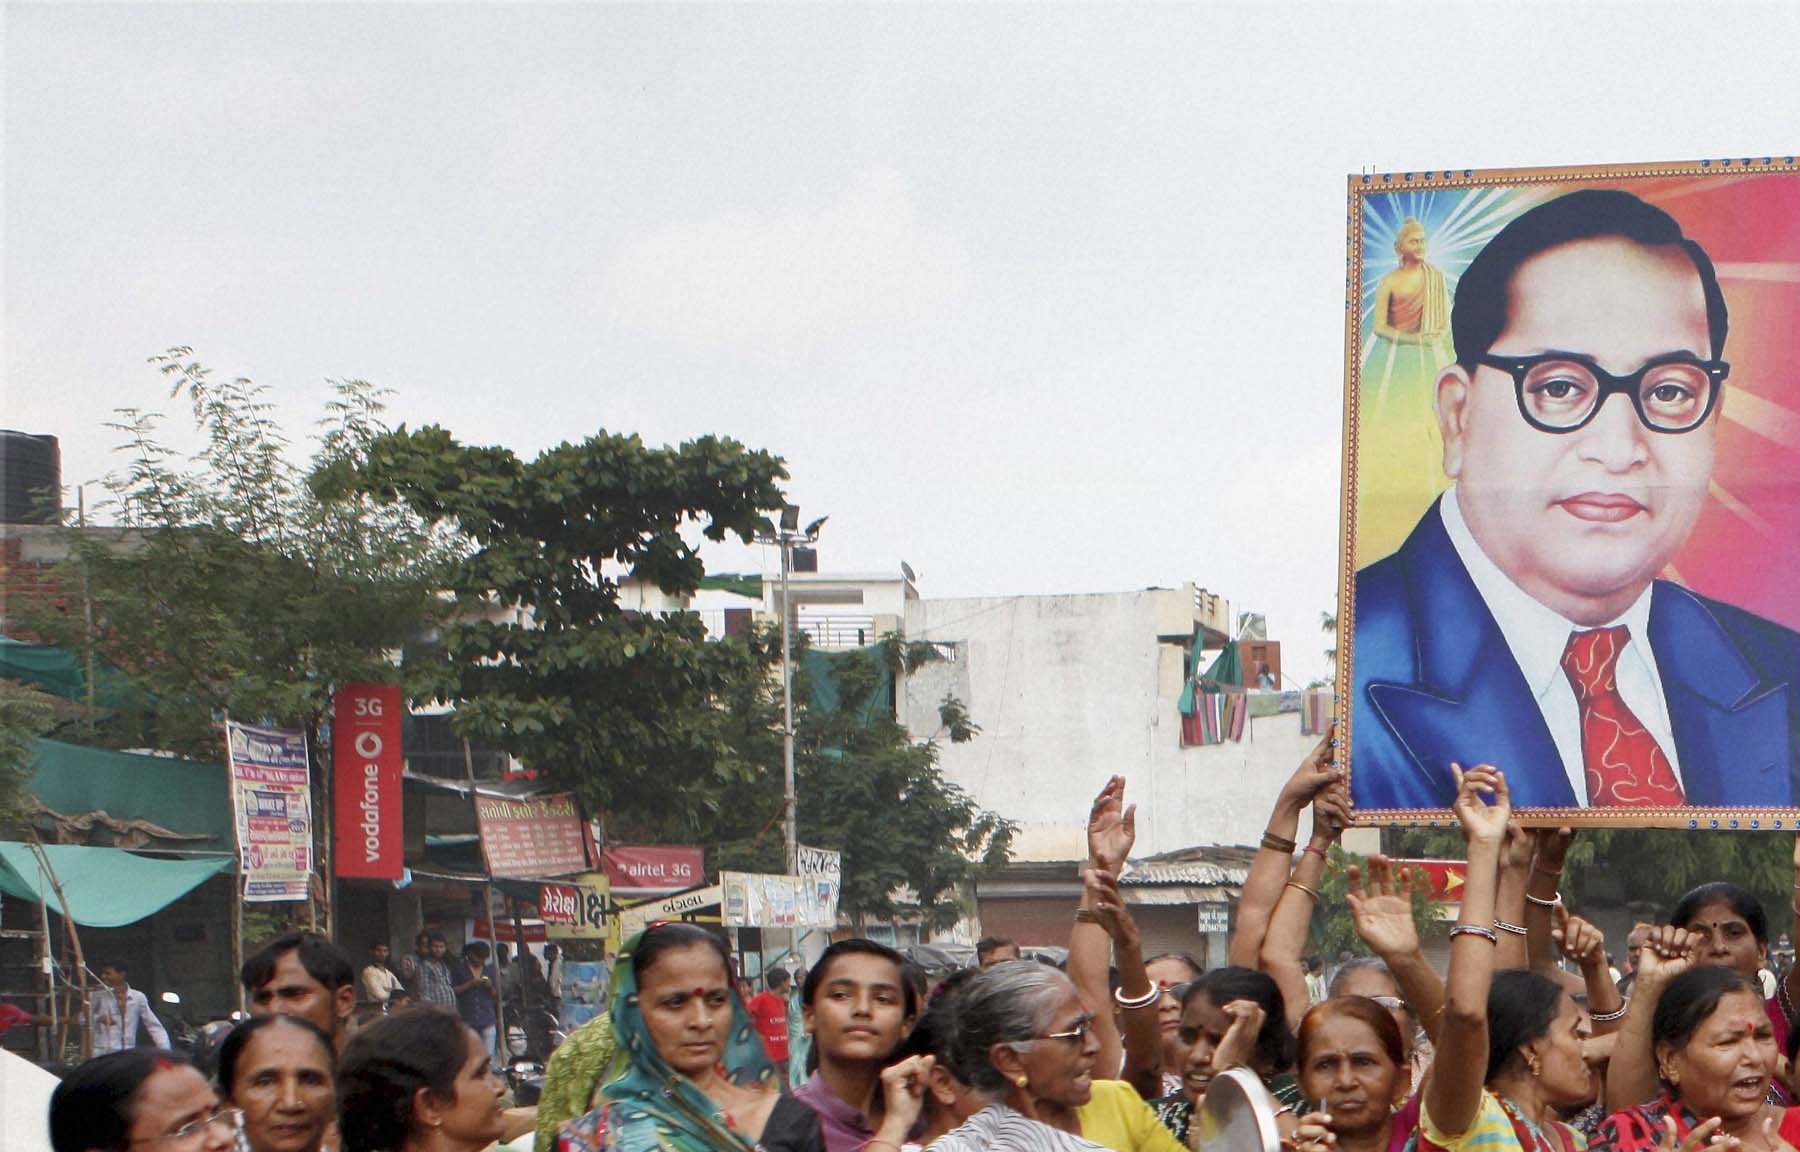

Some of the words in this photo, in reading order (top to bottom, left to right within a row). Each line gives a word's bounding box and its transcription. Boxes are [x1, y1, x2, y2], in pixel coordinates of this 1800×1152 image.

[354, 698, 383, 717] 3G
[360, 764, 381, 864] vodafone
[629, 863, 665, 877] airtel
[672, 864, 691, 877] 3G
